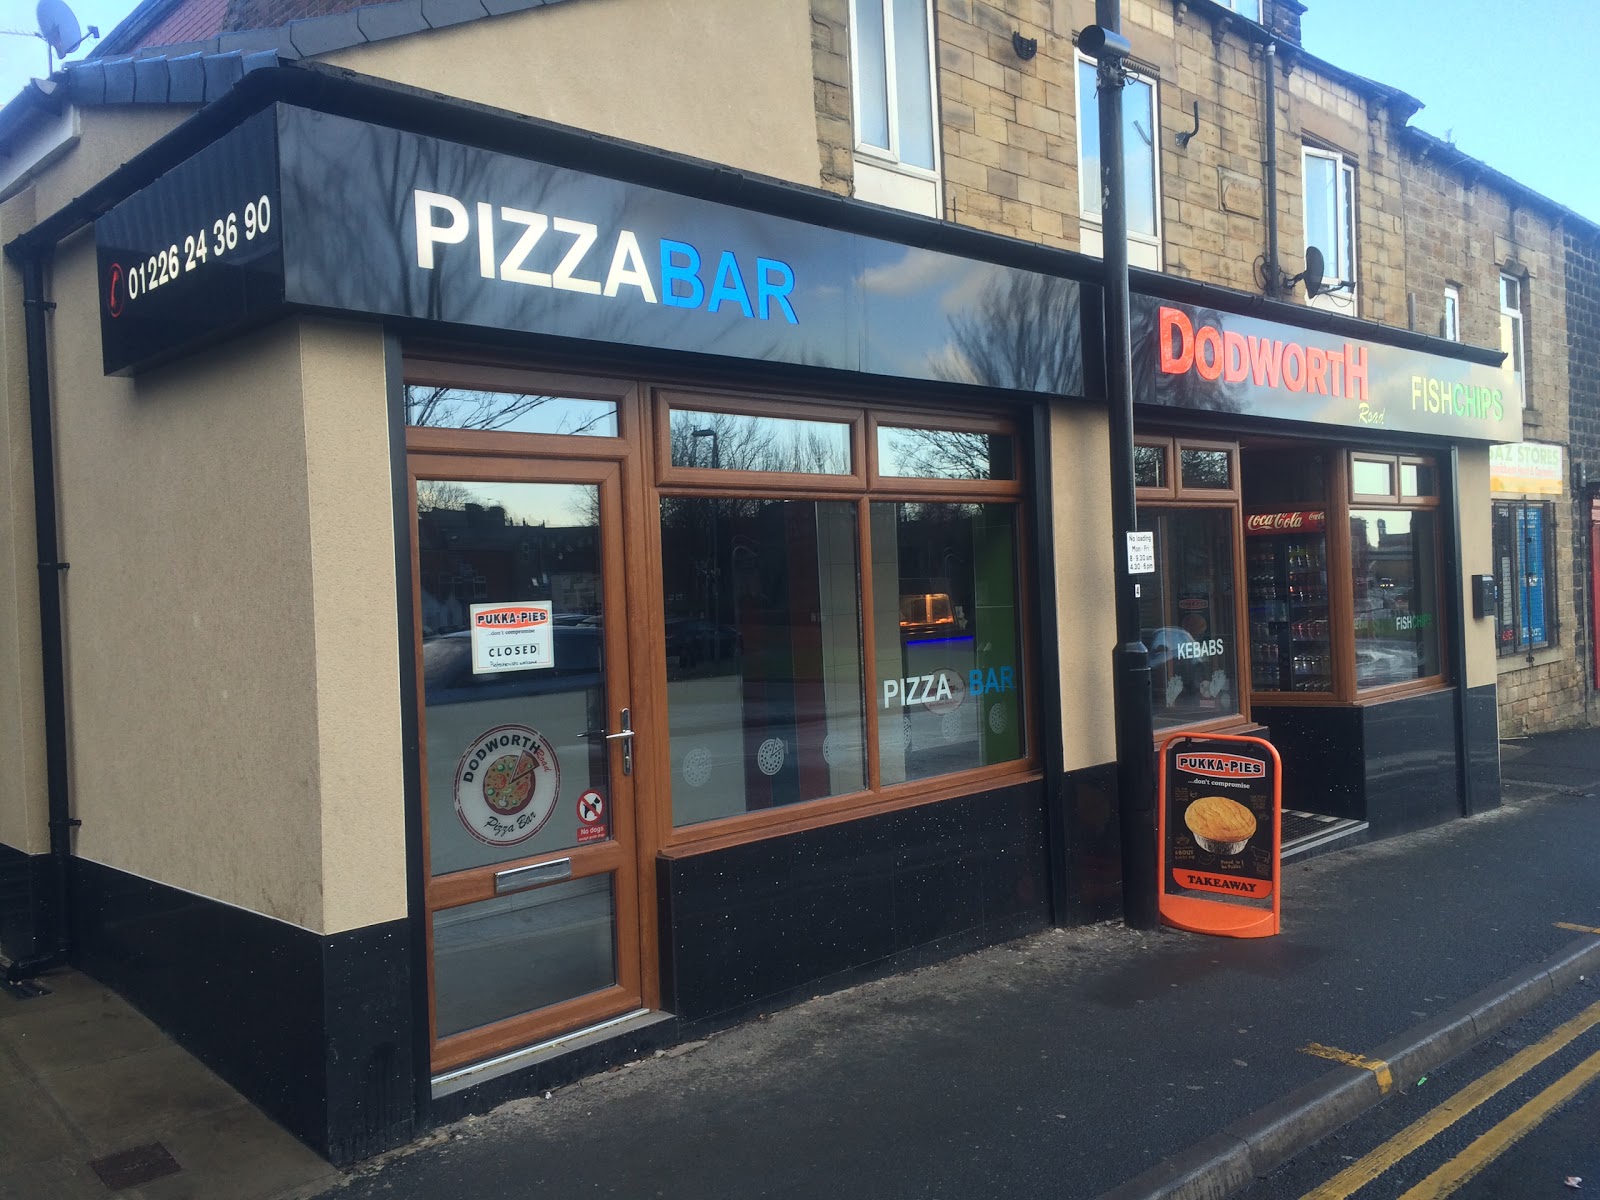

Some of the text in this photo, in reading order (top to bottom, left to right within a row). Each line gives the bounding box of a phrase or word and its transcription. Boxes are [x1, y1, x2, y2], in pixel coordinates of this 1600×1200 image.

[128, 194, 271, 300] 01226 24 36 90
[1159, 306, 1369, 401] DODWORTH
[1358, 402, 1386, 425] Road
[1517, 446, 1559, 466] STORES
[1136, 535, 1152, 543] loading
[477, 612, 547, 625] PUKKA-PIES
[488, 645, 537, 657] CLOSED
[1177, 638, 1224, 660] KEBABS
[883, 665, 1015, 709] PIZZA BAR
[463, 735, 541, 783] DODWORTH
[1180, 758, 1261, 773] PUKKA-PIES
[1211, 780, 1251, 789] compromise
[484, 812, 537, 837] Pizza Bar
[589, 825, 604, 834] dogs
[1187, 875, 1257, 893] TAKEAWAY
